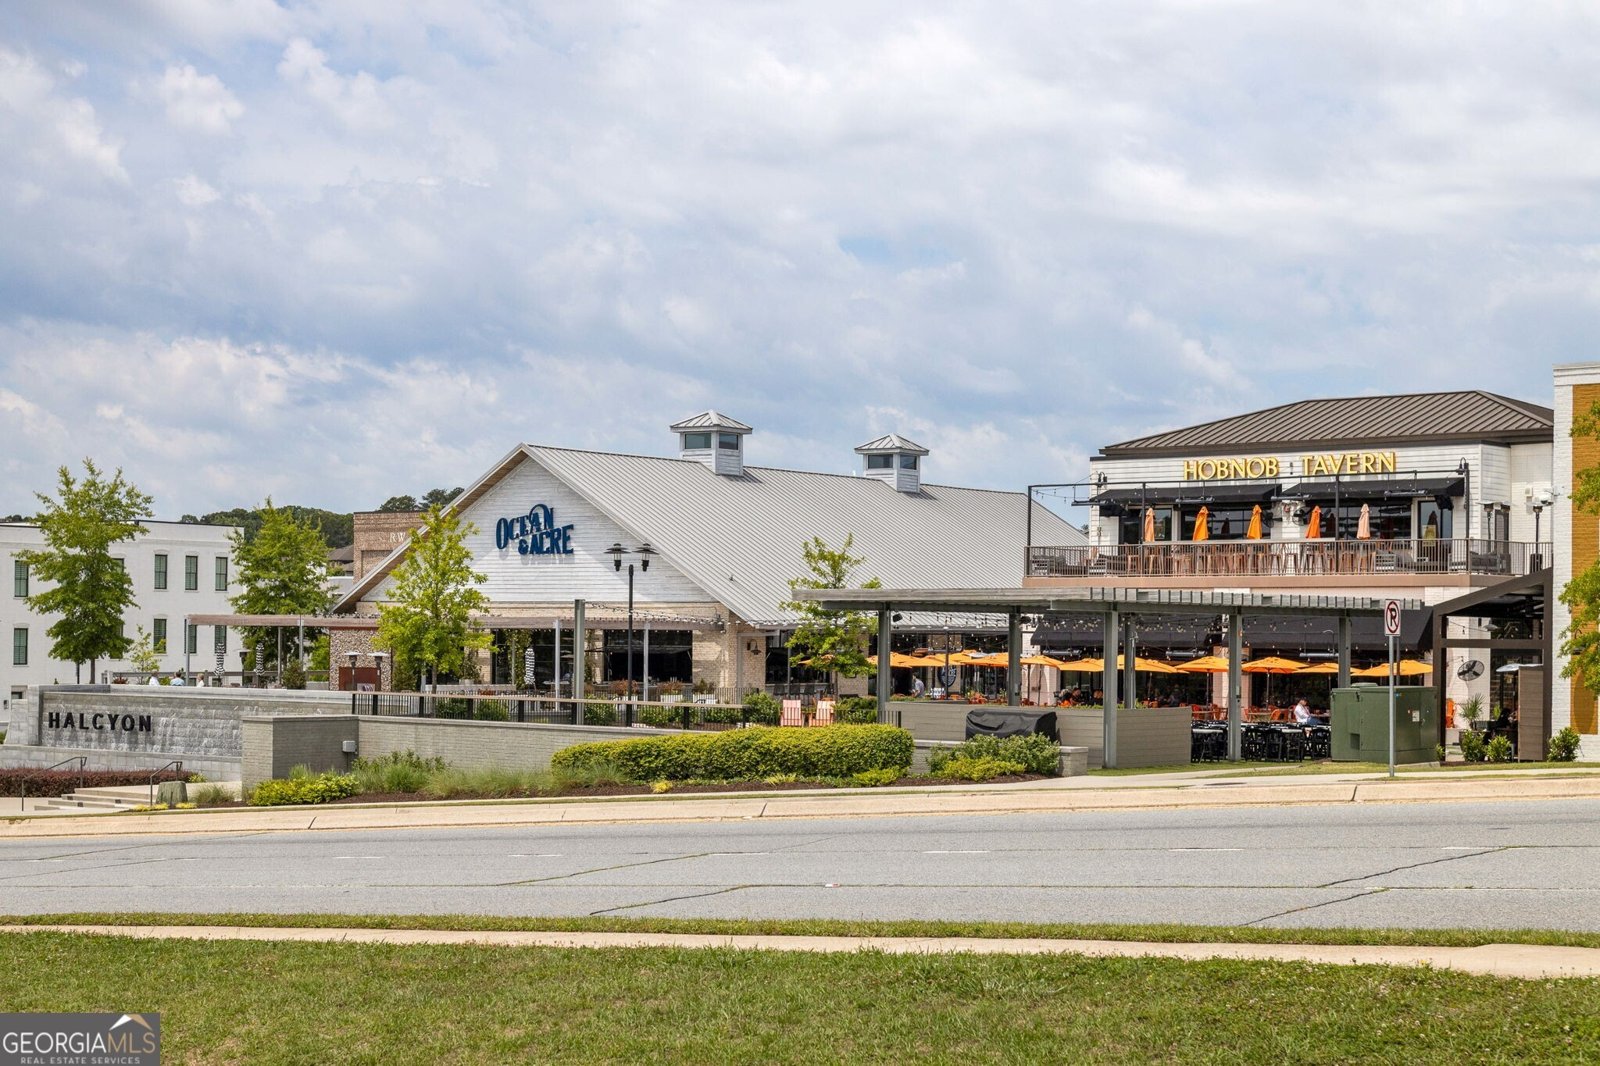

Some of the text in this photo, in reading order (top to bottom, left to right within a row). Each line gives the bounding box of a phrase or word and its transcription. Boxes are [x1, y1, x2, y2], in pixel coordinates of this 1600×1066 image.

[1183, 451, 1397, 480] HOBNOB TAVERN
[496, 503, 554, 549] OCEAN
[48, 712, 152, 732] HALCYON
